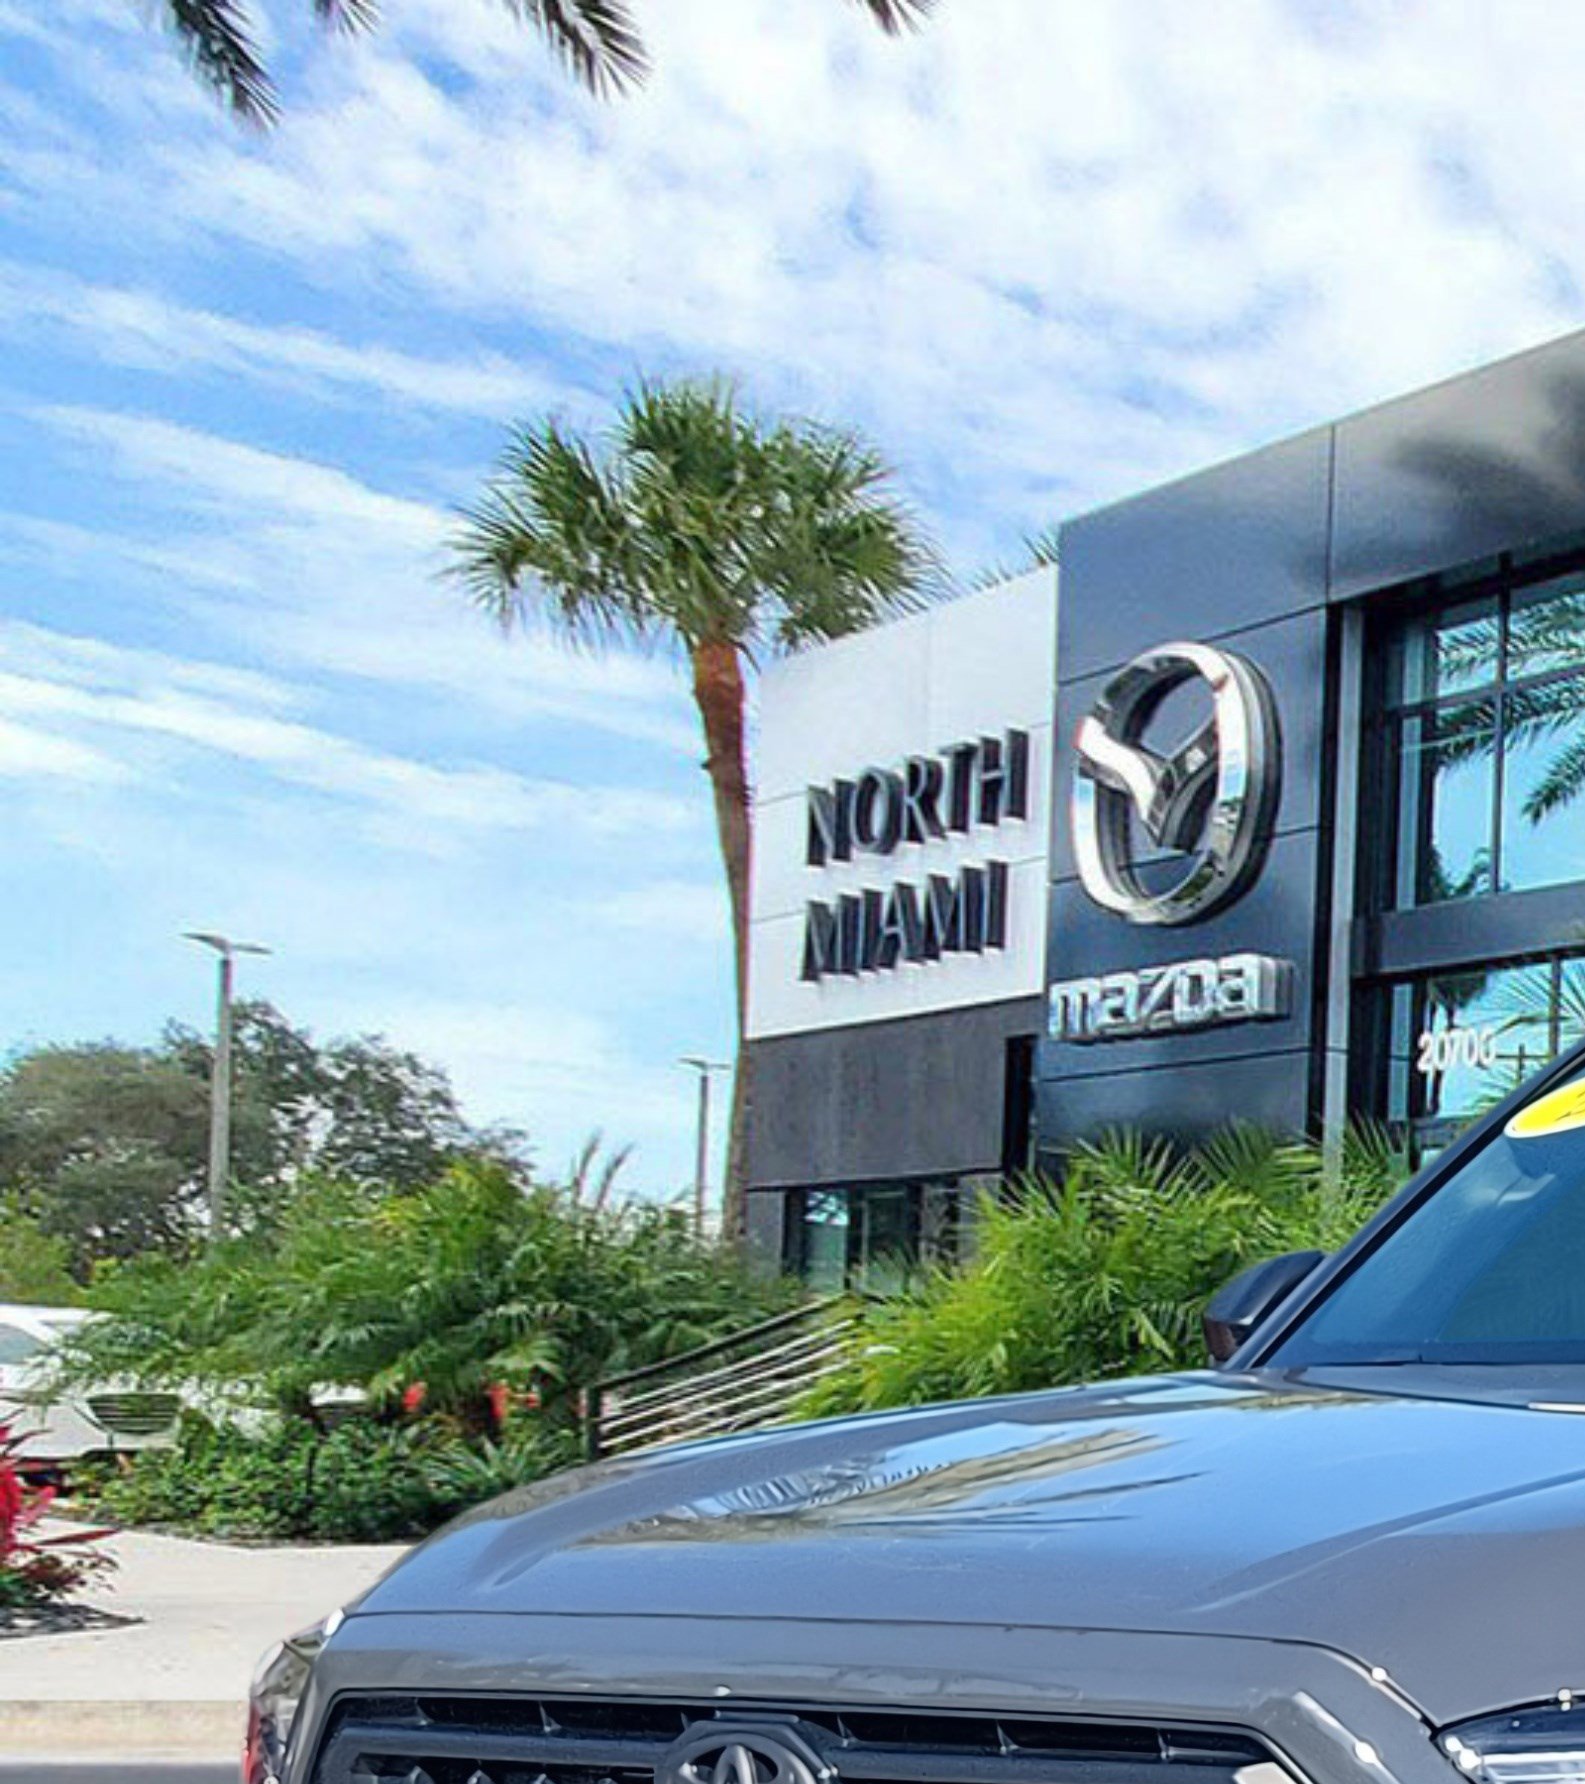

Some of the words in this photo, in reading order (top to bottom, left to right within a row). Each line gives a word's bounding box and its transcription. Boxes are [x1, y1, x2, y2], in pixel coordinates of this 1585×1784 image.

[806, 729, 1029, 867] NORTH
[799, 860, 1008, 981] MIAMI
[1048, 952, 1288, 1042] mazda
